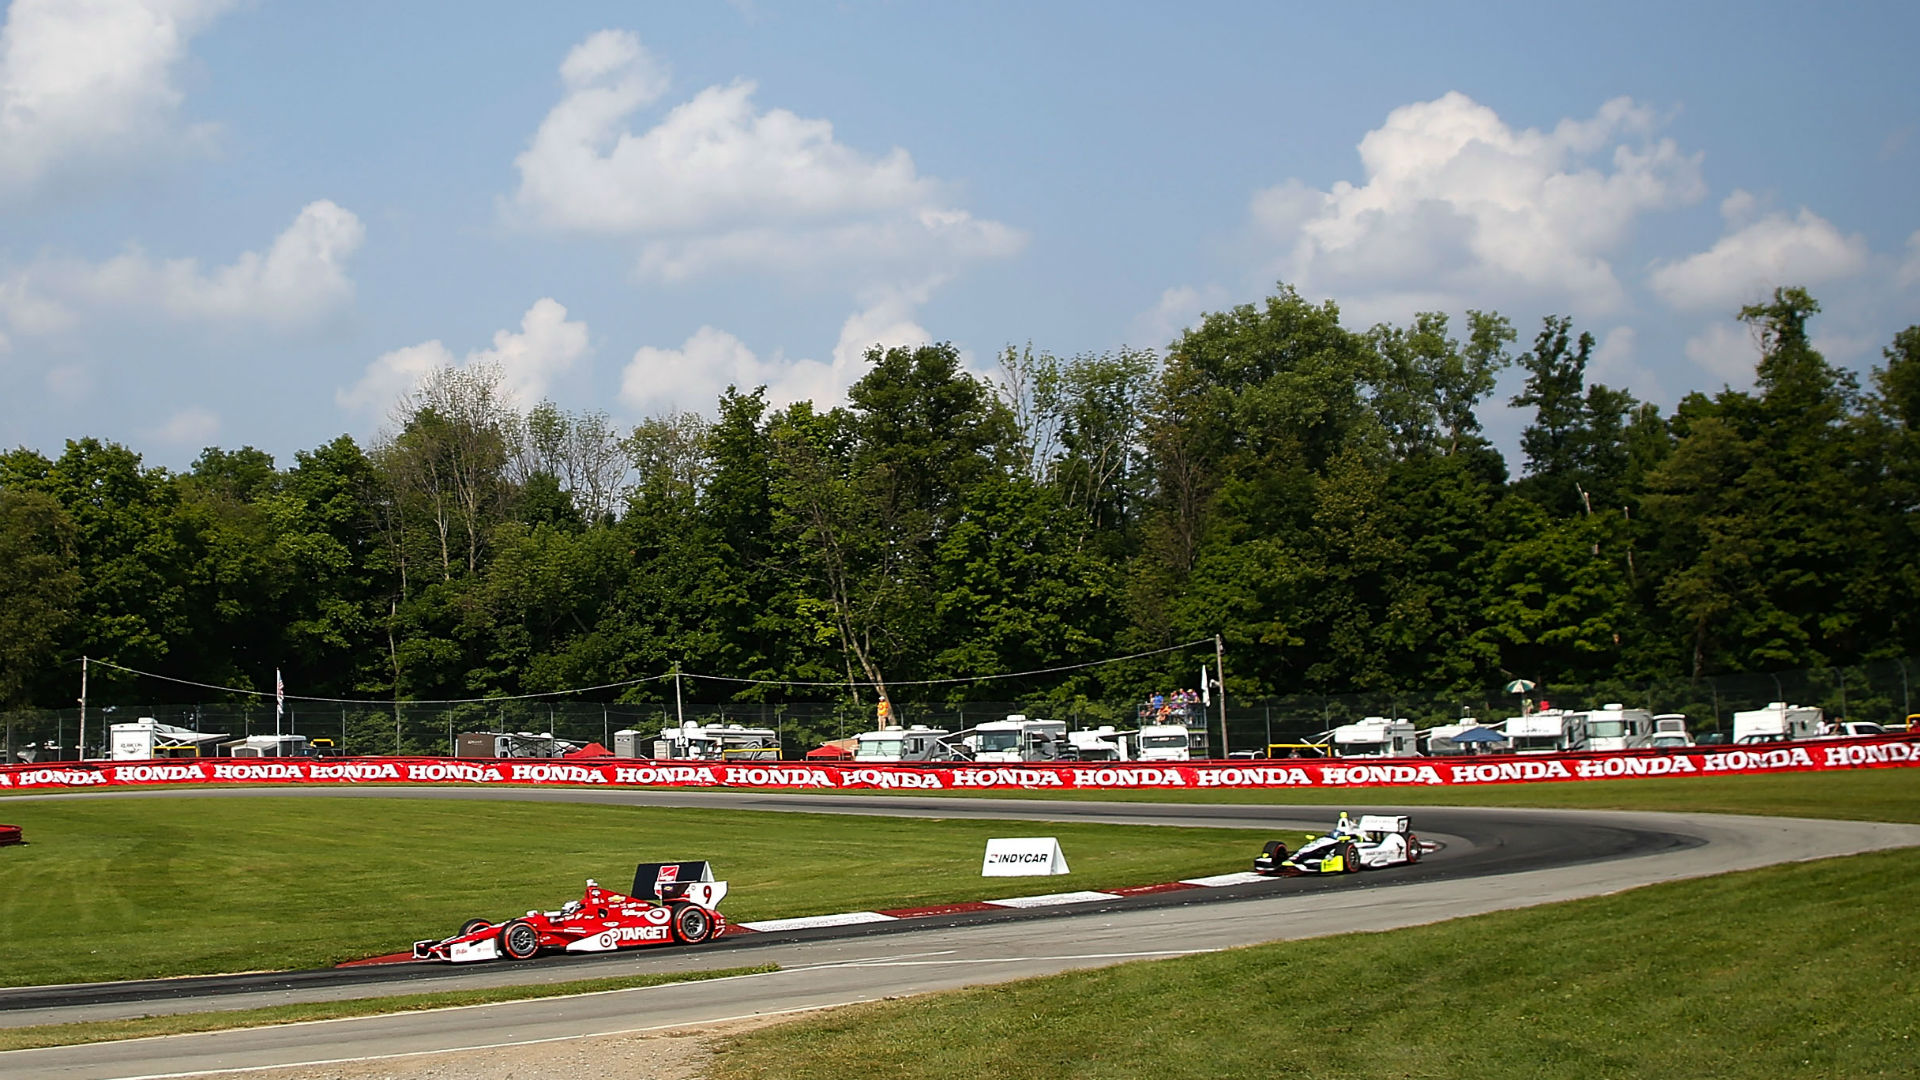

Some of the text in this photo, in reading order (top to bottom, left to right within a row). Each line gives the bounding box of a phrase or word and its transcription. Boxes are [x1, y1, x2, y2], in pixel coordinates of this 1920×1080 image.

[677, 736, 686, 747] 12
[1703, 748, 1813, 770] HONDA
[1824, 743, 1920, 765] HONDA
[115, 765, 205, 781] HONDA
[214, 765, 303, 778] HONDA
[310, 764, 399, 782] HONDA
[408, 765, 503, 782] HONDA
[512, 764, 607, 782] HONDA
[616, 767, 717, 783] HONDA
[1320, 766, 1442, 784] HONDA
[1451, 761, 1571, 782] HONDA
[1576, 756, 1696, 777] HONDA
[19, 770, 106, 785] HONDA
[726, 768, 835, 787] HONDA
[841, 770, 942, 788] HONDA
[952, 768, 1063, 788] HONDA
[1073, 769, 1184, 787] HONDA
[1197, 768, 1312, 785] HONDA
[998, 853, 1048, 863] INDYCAR
[703, 885, 712, 904] 9
[620, 926, 669, 940] TARGET
